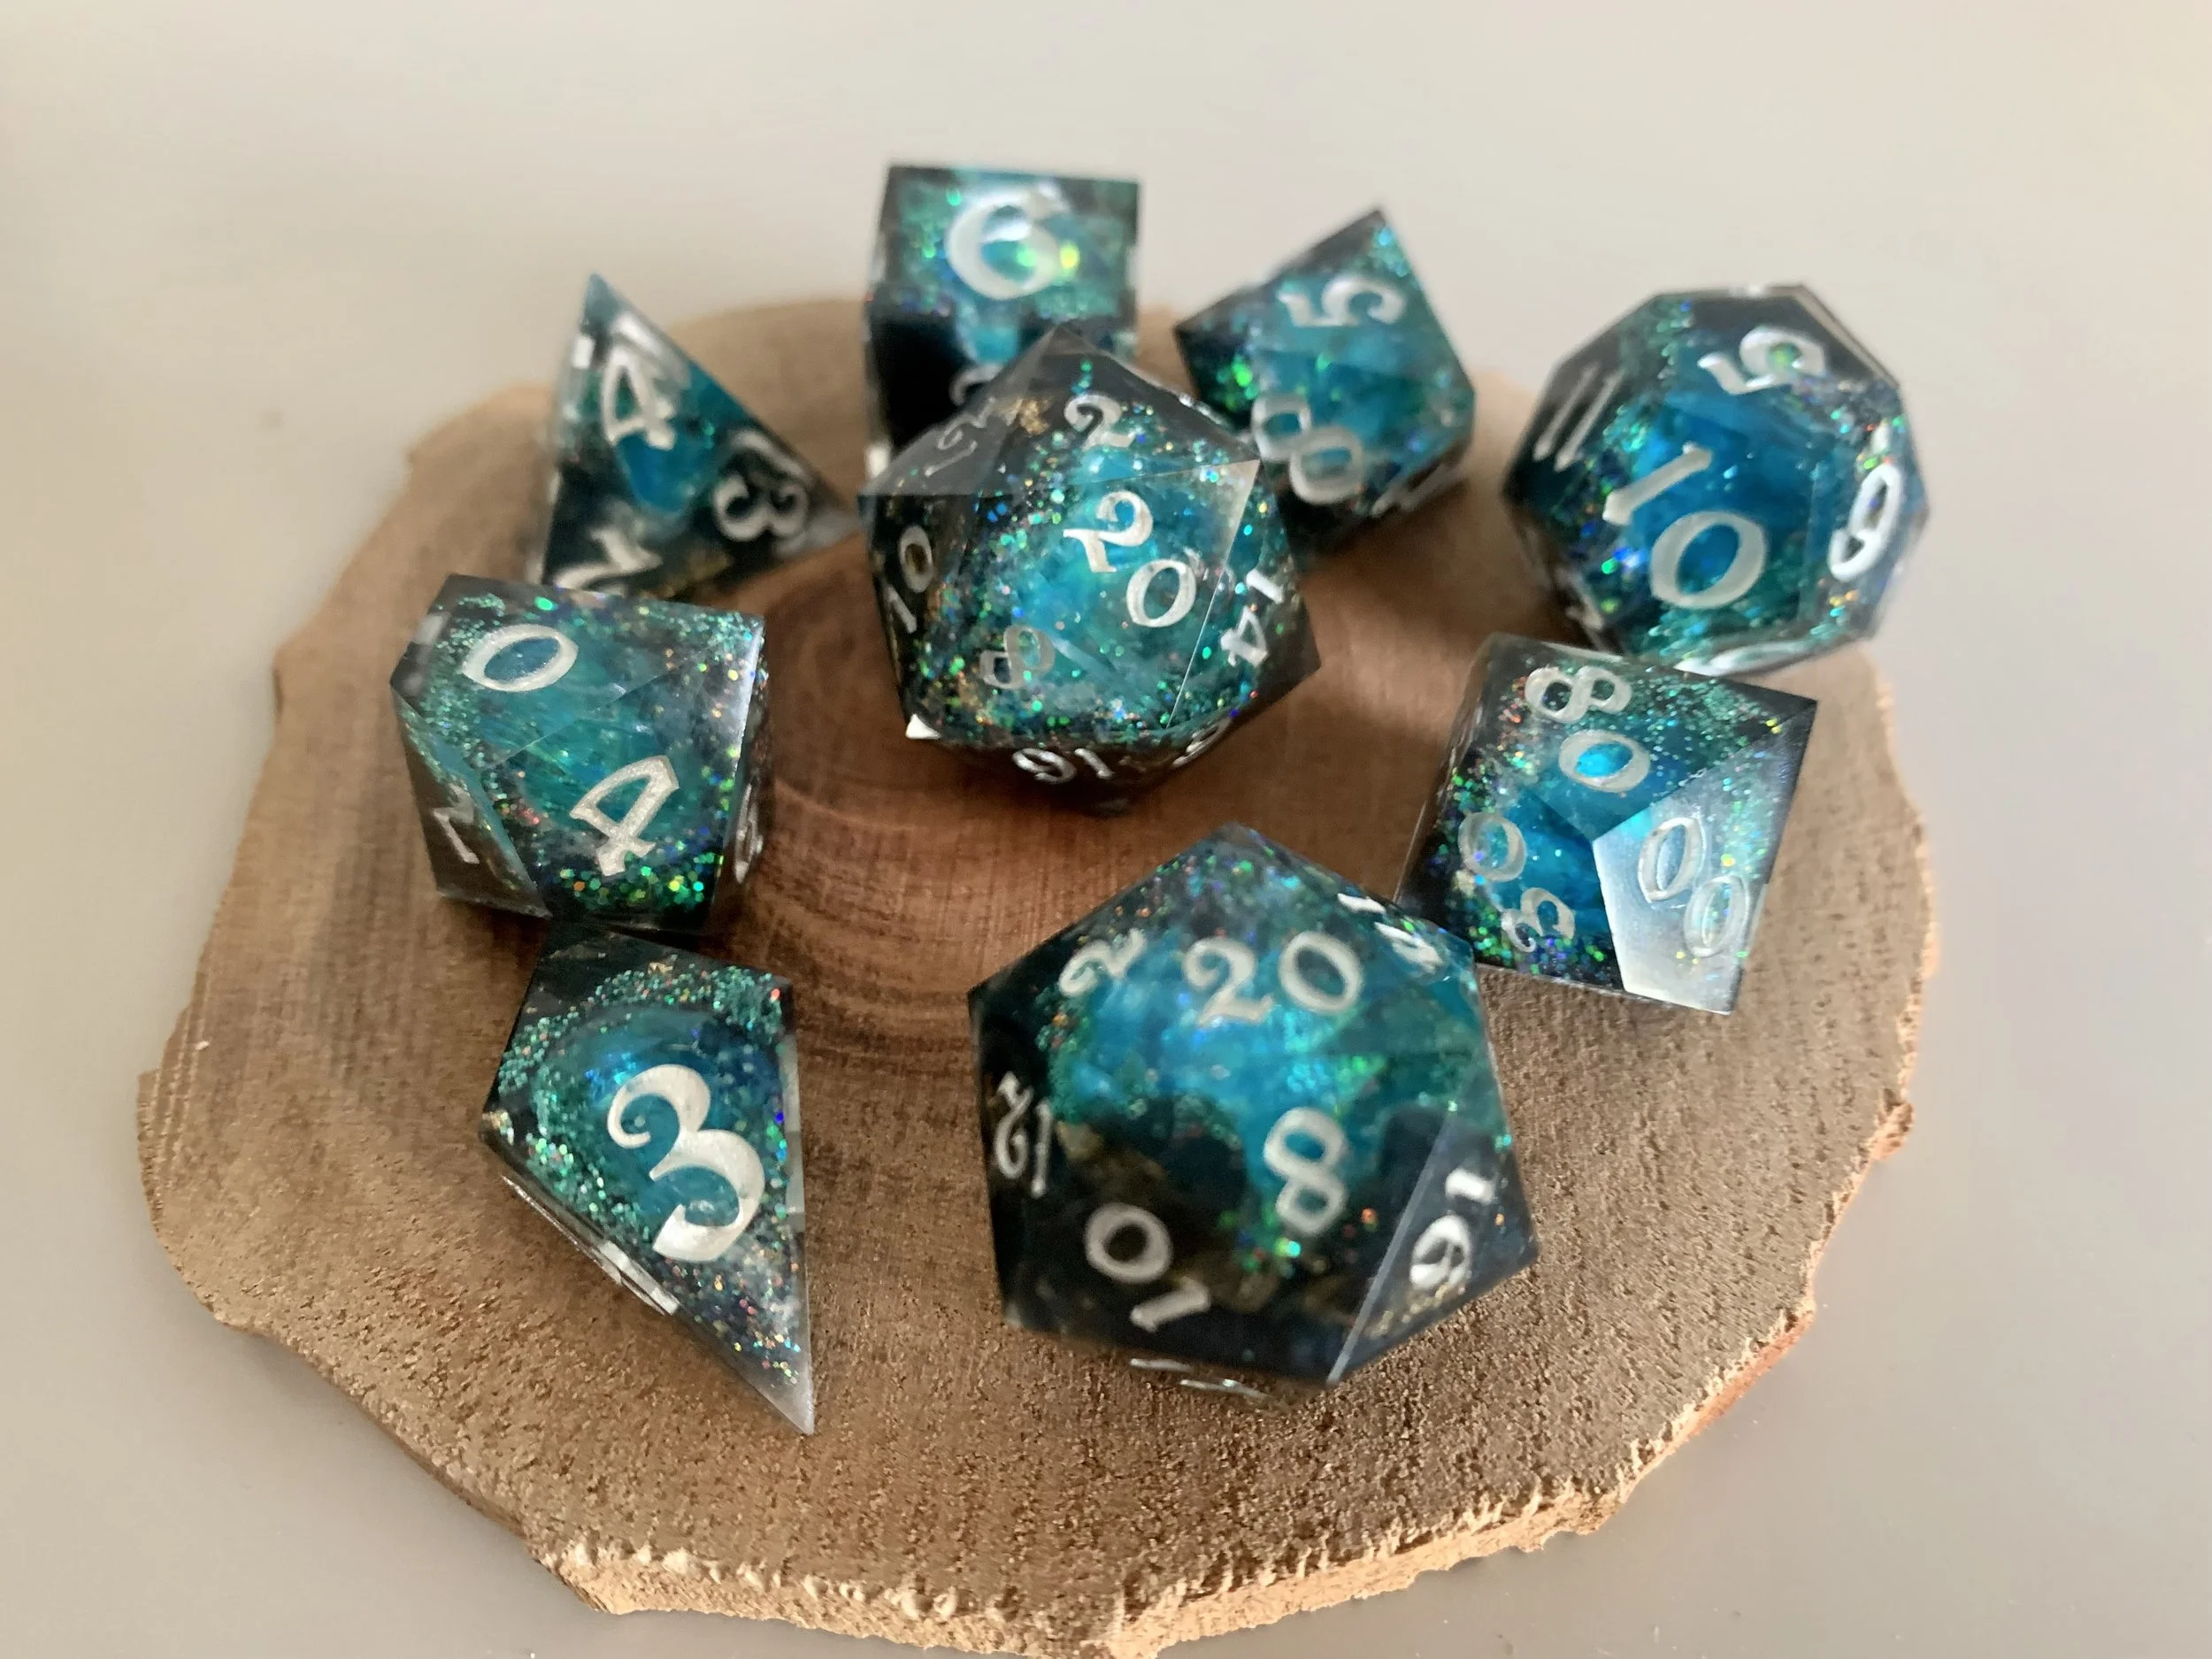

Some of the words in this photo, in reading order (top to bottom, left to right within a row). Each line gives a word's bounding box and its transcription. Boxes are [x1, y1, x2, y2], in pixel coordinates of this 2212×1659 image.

[945, 180, 1071, 301] 6
[1277, 273, 1405, 326] 5
[601, 343, 676, 449] 4
[1064, 395, 1136, 449] 2
[1250, 395, 1365, 505] 8
[1532, 361, 1625, 474] 11
[713, 469, 809, 545] 3
[1064, 491, 1196, 627] 20
[1603, 442, 1766, 609] 10
[887, 526, 934, 634] 10
[1220, 568, 1285, 668] 14
[462, 624, 579, 692] 0
[979, 625, 1056, 689] 8
[1525, 664, 1651, 793] 80
[569, 756, 680, 876] 4
[1058, 927, 1148, 996] 2
[1182, 931, 1363, 1027] 20
[606, 1064, 765, 1263] 3
[1263, 1106, 1348, 1237] 8
[1084, 1202, 1212, 1333] 10
